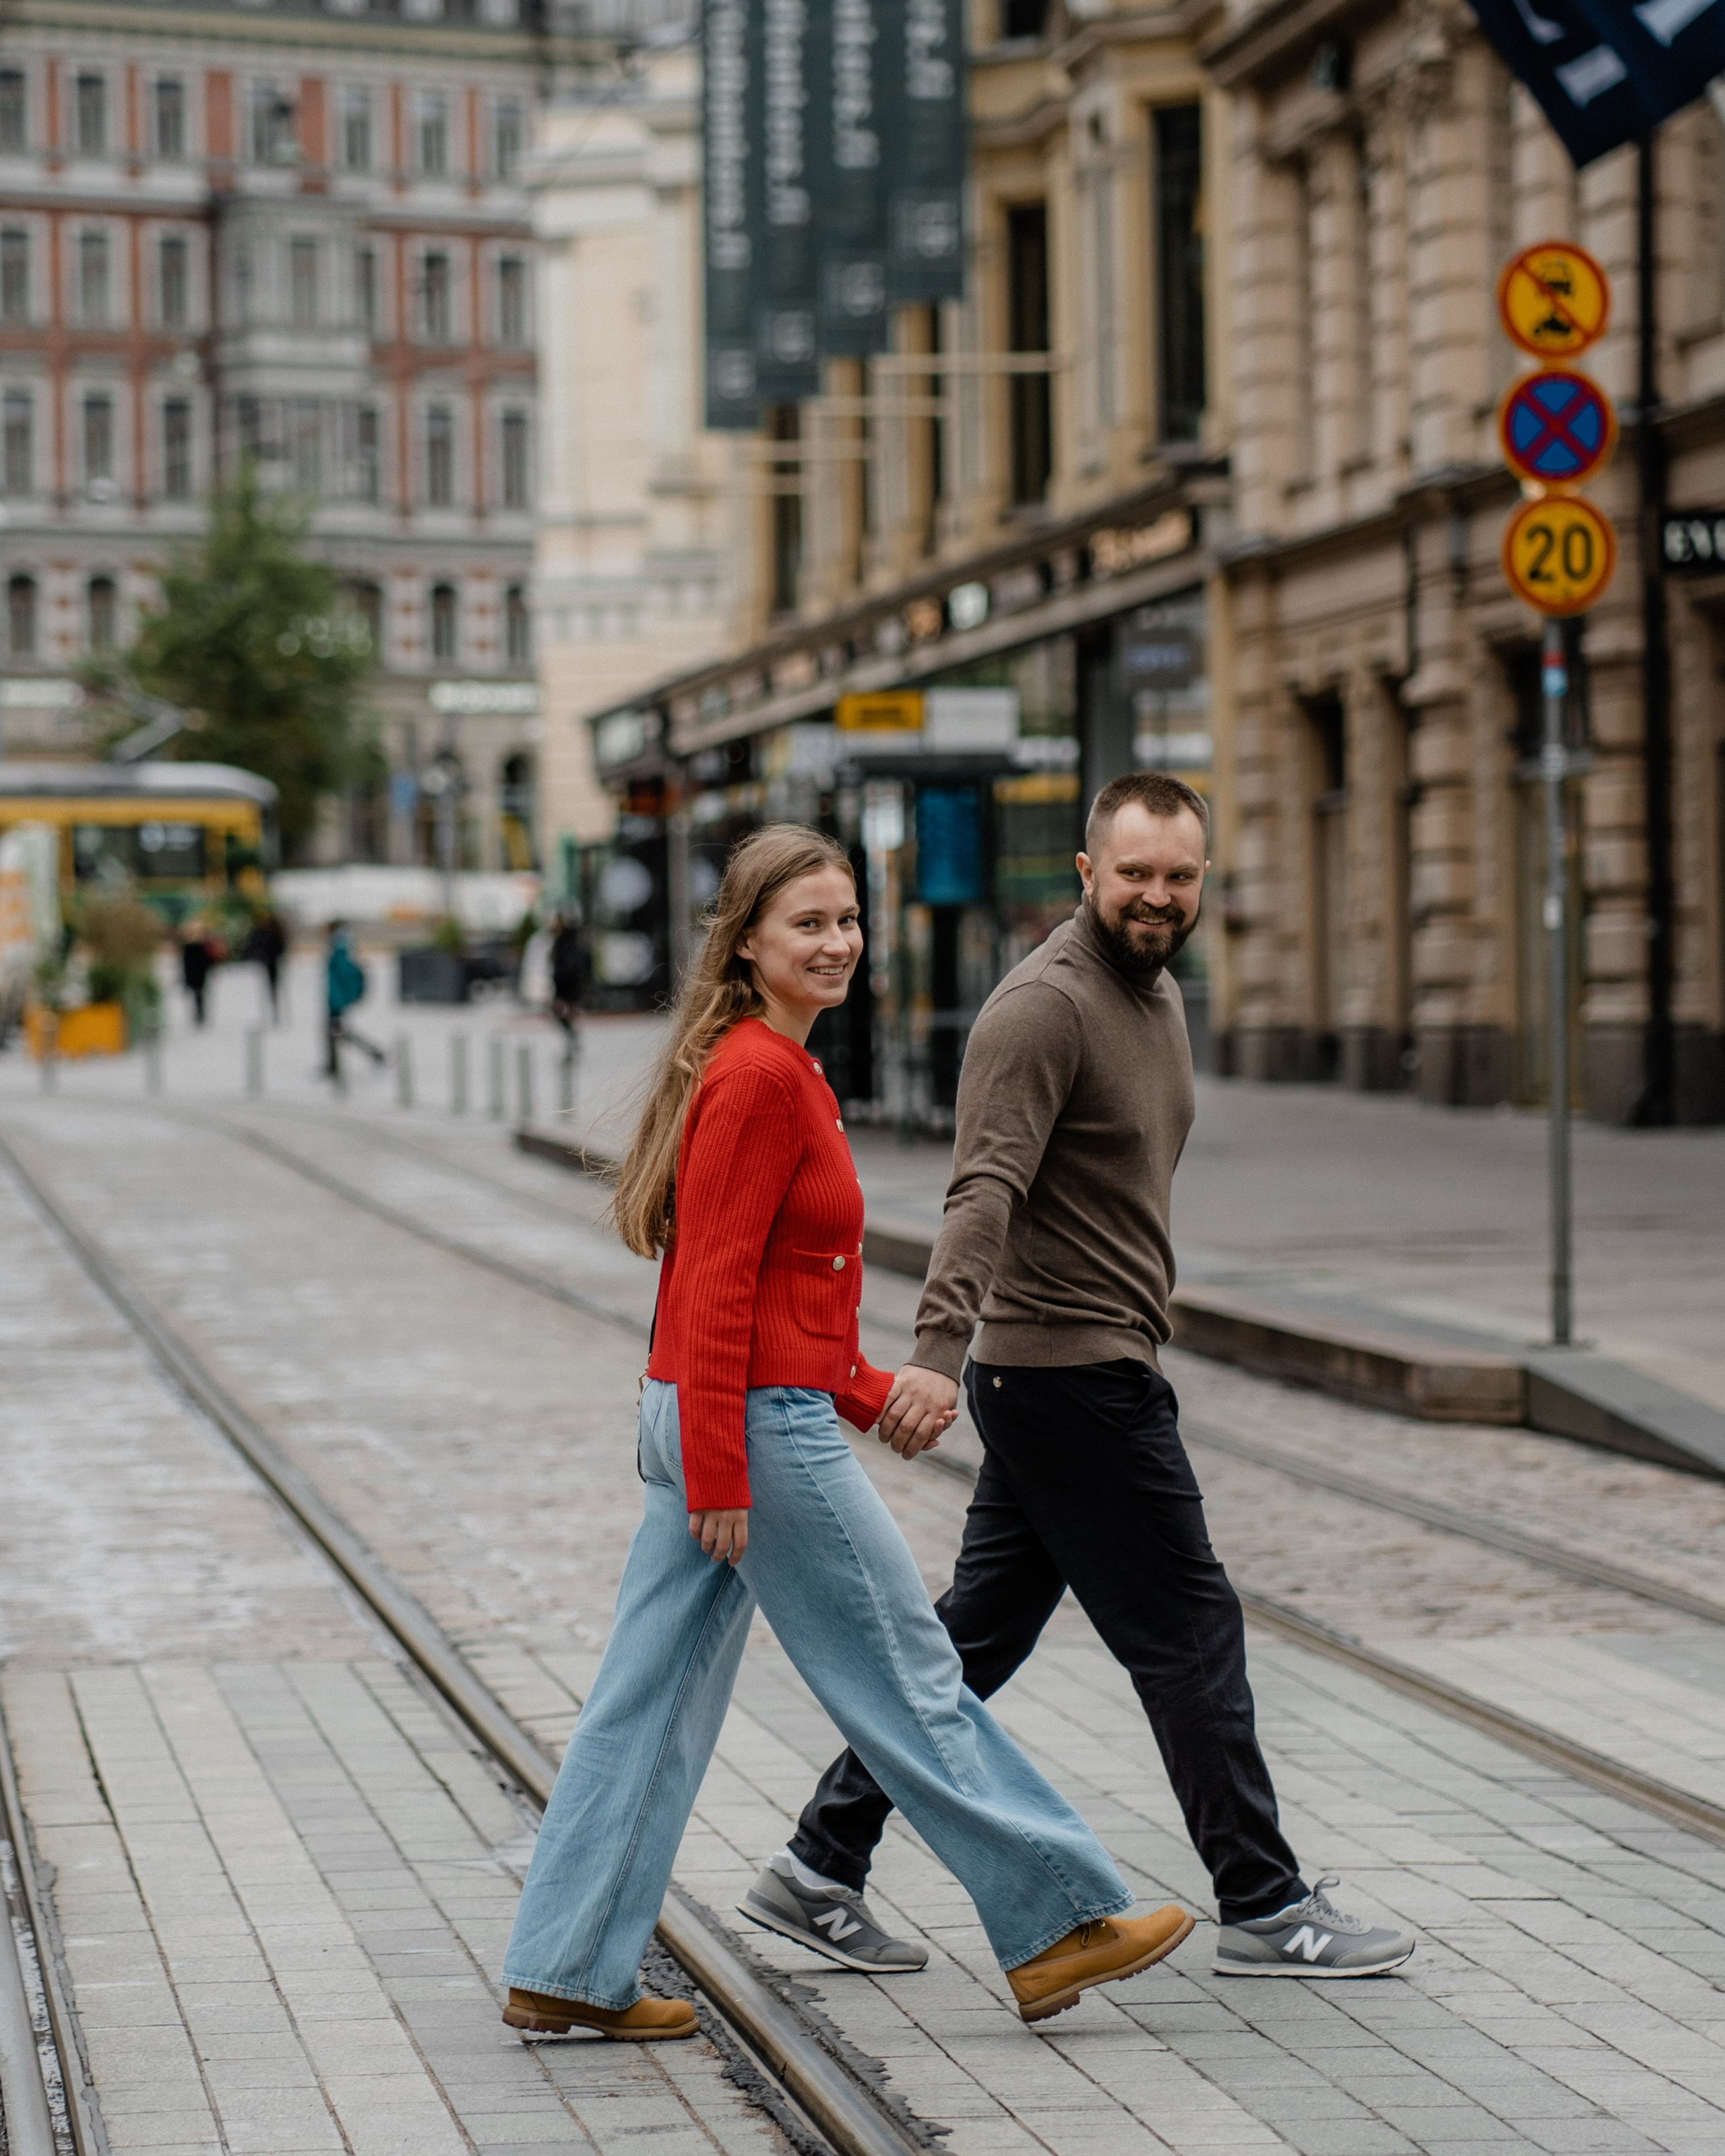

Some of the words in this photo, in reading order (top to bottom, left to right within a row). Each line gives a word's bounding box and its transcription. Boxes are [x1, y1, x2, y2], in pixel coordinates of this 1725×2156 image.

[1526, 524, 1593, 581] 20
[812, 1907, 862, 1942] N
[1282, 1925, 1335, 1962] N
